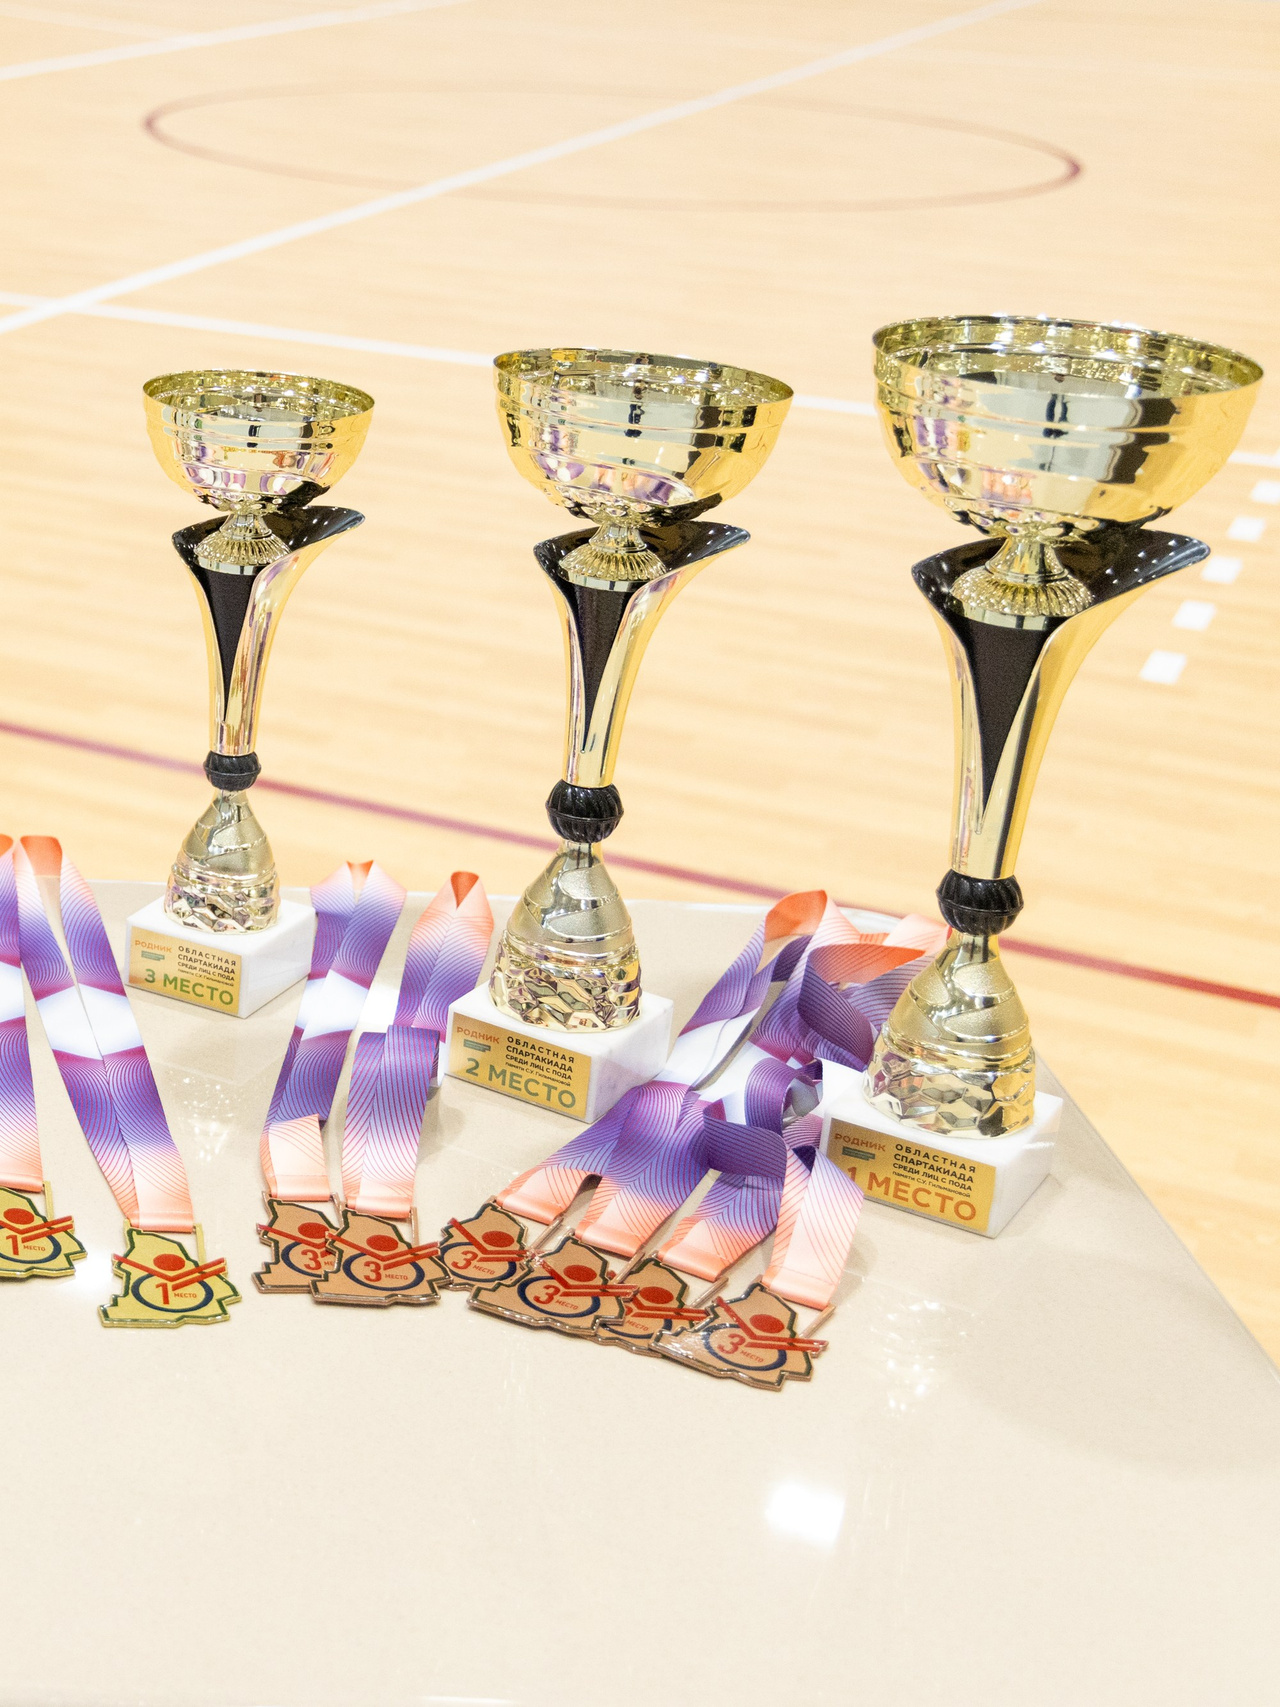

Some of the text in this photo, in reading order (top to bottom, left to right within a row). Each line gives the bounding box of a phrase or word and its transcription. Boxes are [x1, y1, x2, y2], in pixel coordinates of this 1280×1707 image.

[134, 940, 172, 954] РОДНИК
[178, 946, 236, 966] ОБЛАСТНАЯ
[178, 954, 236, 974] СПАРТАКИАДА
[178, 962, 198, 970] СРЕДИ
[218, 972, 234, 982] ПОДА
[144, 968, 156, 984] 3
[163, 974, 234, 1006] МЕСТО
[456, 1026, 500, 1044] РОДНИК
[506, 1046, 573, 1073] СПАРТАКИАДА
[507, 1036, 574, 1063] ОБЛАСТНАЯ
[506, 1054, 528, 1065] СРЕДИ
[530, 1062, 544, 1072] ЛИЦ
[552, 1070, 572, 1080] ПОДА
[465, 1058, 576, 1109] 2 МЕСТО
[834, 1133, 886, 1152] РОДНИК
[894, 1154, 974, 1183] СПАРТАКИАДА
[896, 1144, 976, 1173] ОБЛАСТНАЯ
[892, 1162, 920, 1175] СРЕДИ
[922, 1172, 938, 1182] ЛИЦ
[948, 1180, 972, 1191] ПОДА
[847, 1166, 976, 1221] 1 МЕСТО
[6, 1234, 20, 1256] 1
[301, 1248, 321, 1270] 3
[363, 1260, 382, 1282] 3
[451, 1250, 496, 1276] 3 МЕСТО
[156, 1282, 170, 1304] 1
[533, 1284, 578, 1310] 3 МЕСТО
[717, 1332, 764, 1363] 3 МЕСТО
